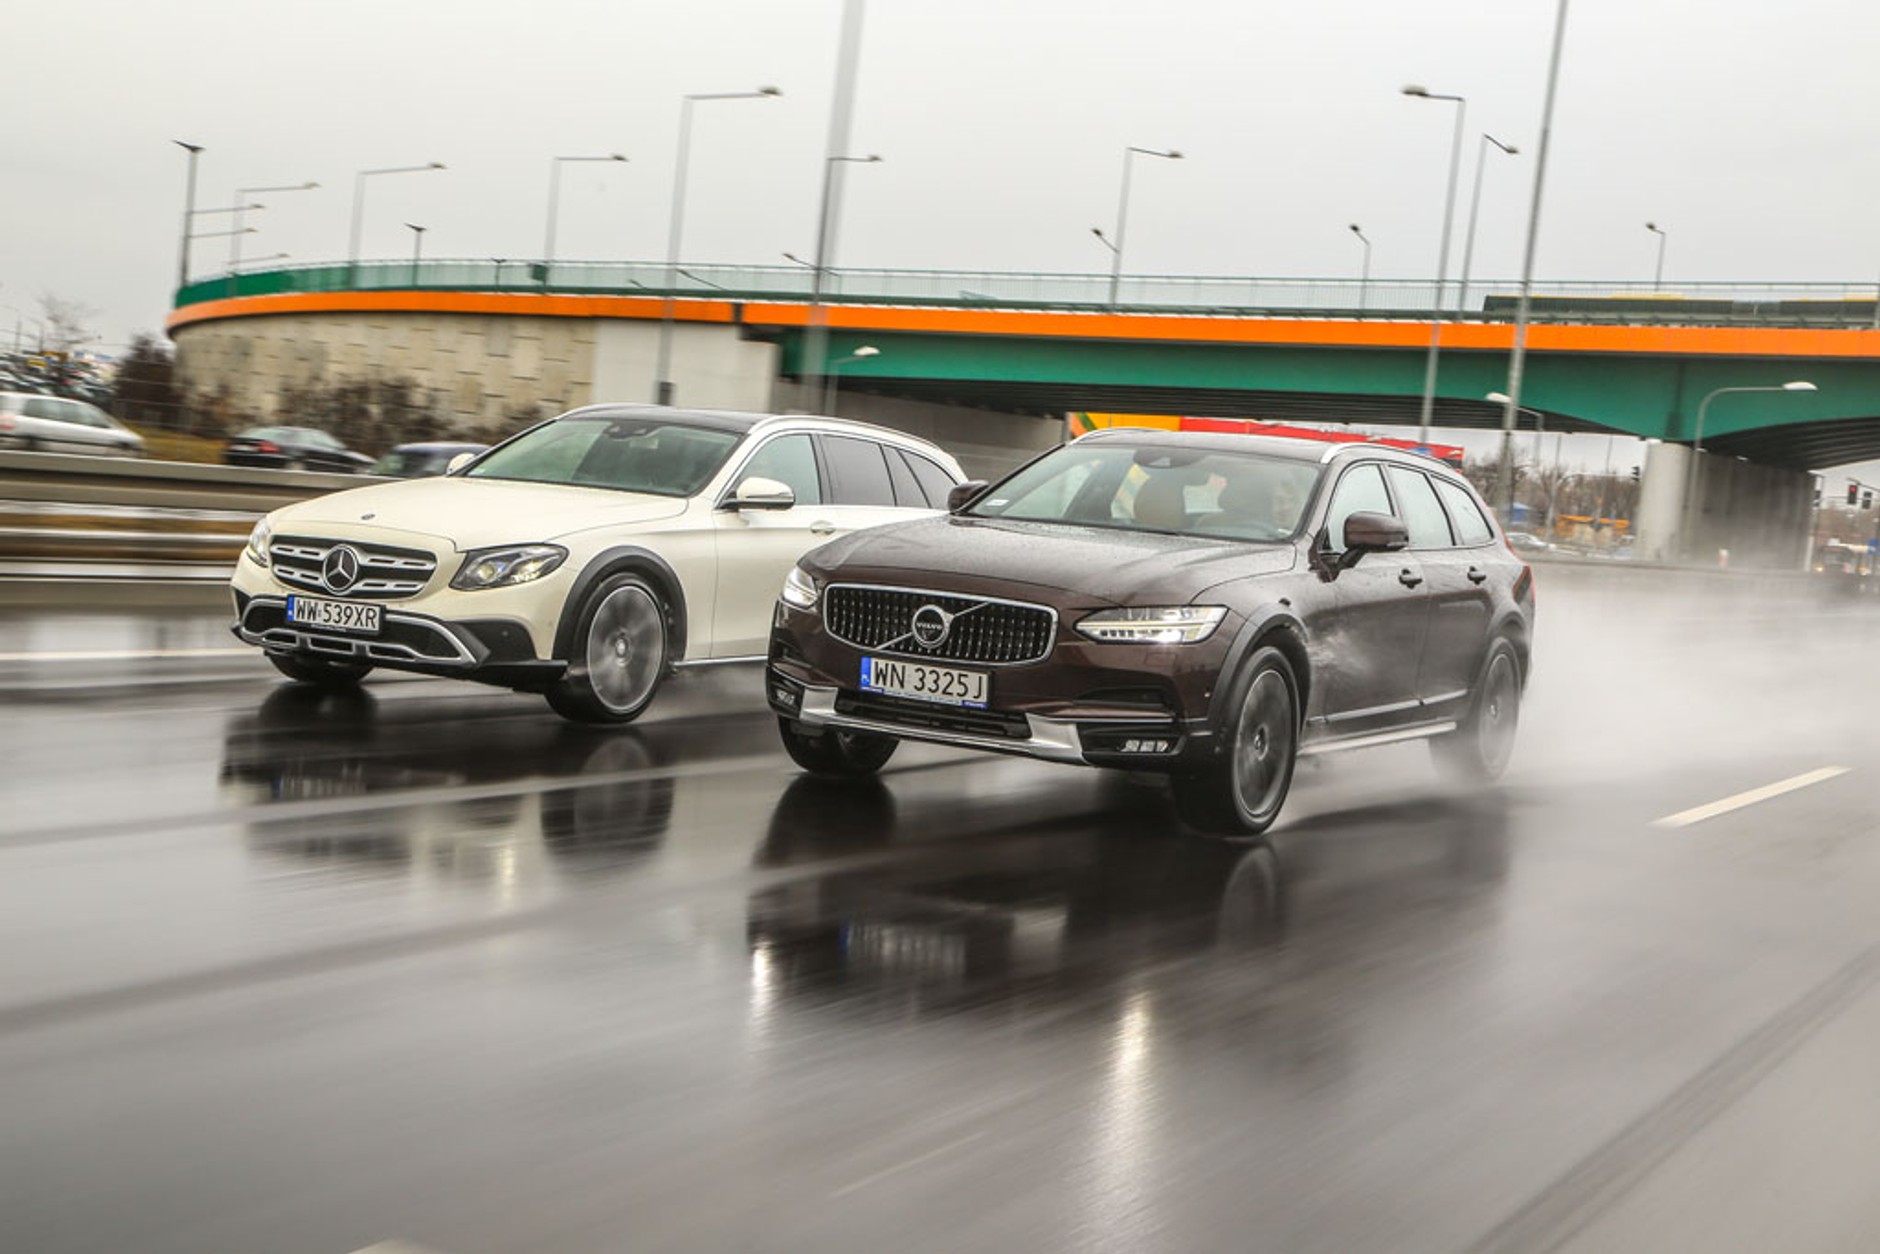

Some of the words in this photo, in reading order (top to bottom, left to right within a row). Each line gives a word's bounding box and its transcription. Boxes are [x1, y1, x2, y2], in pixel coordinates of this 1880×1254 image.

[295, 598, 318, 621] WW
[322, 603, 378, 629] 539XR
[874, 661, 906, 689] WN
[914, 667, 983, 699] 3325J
